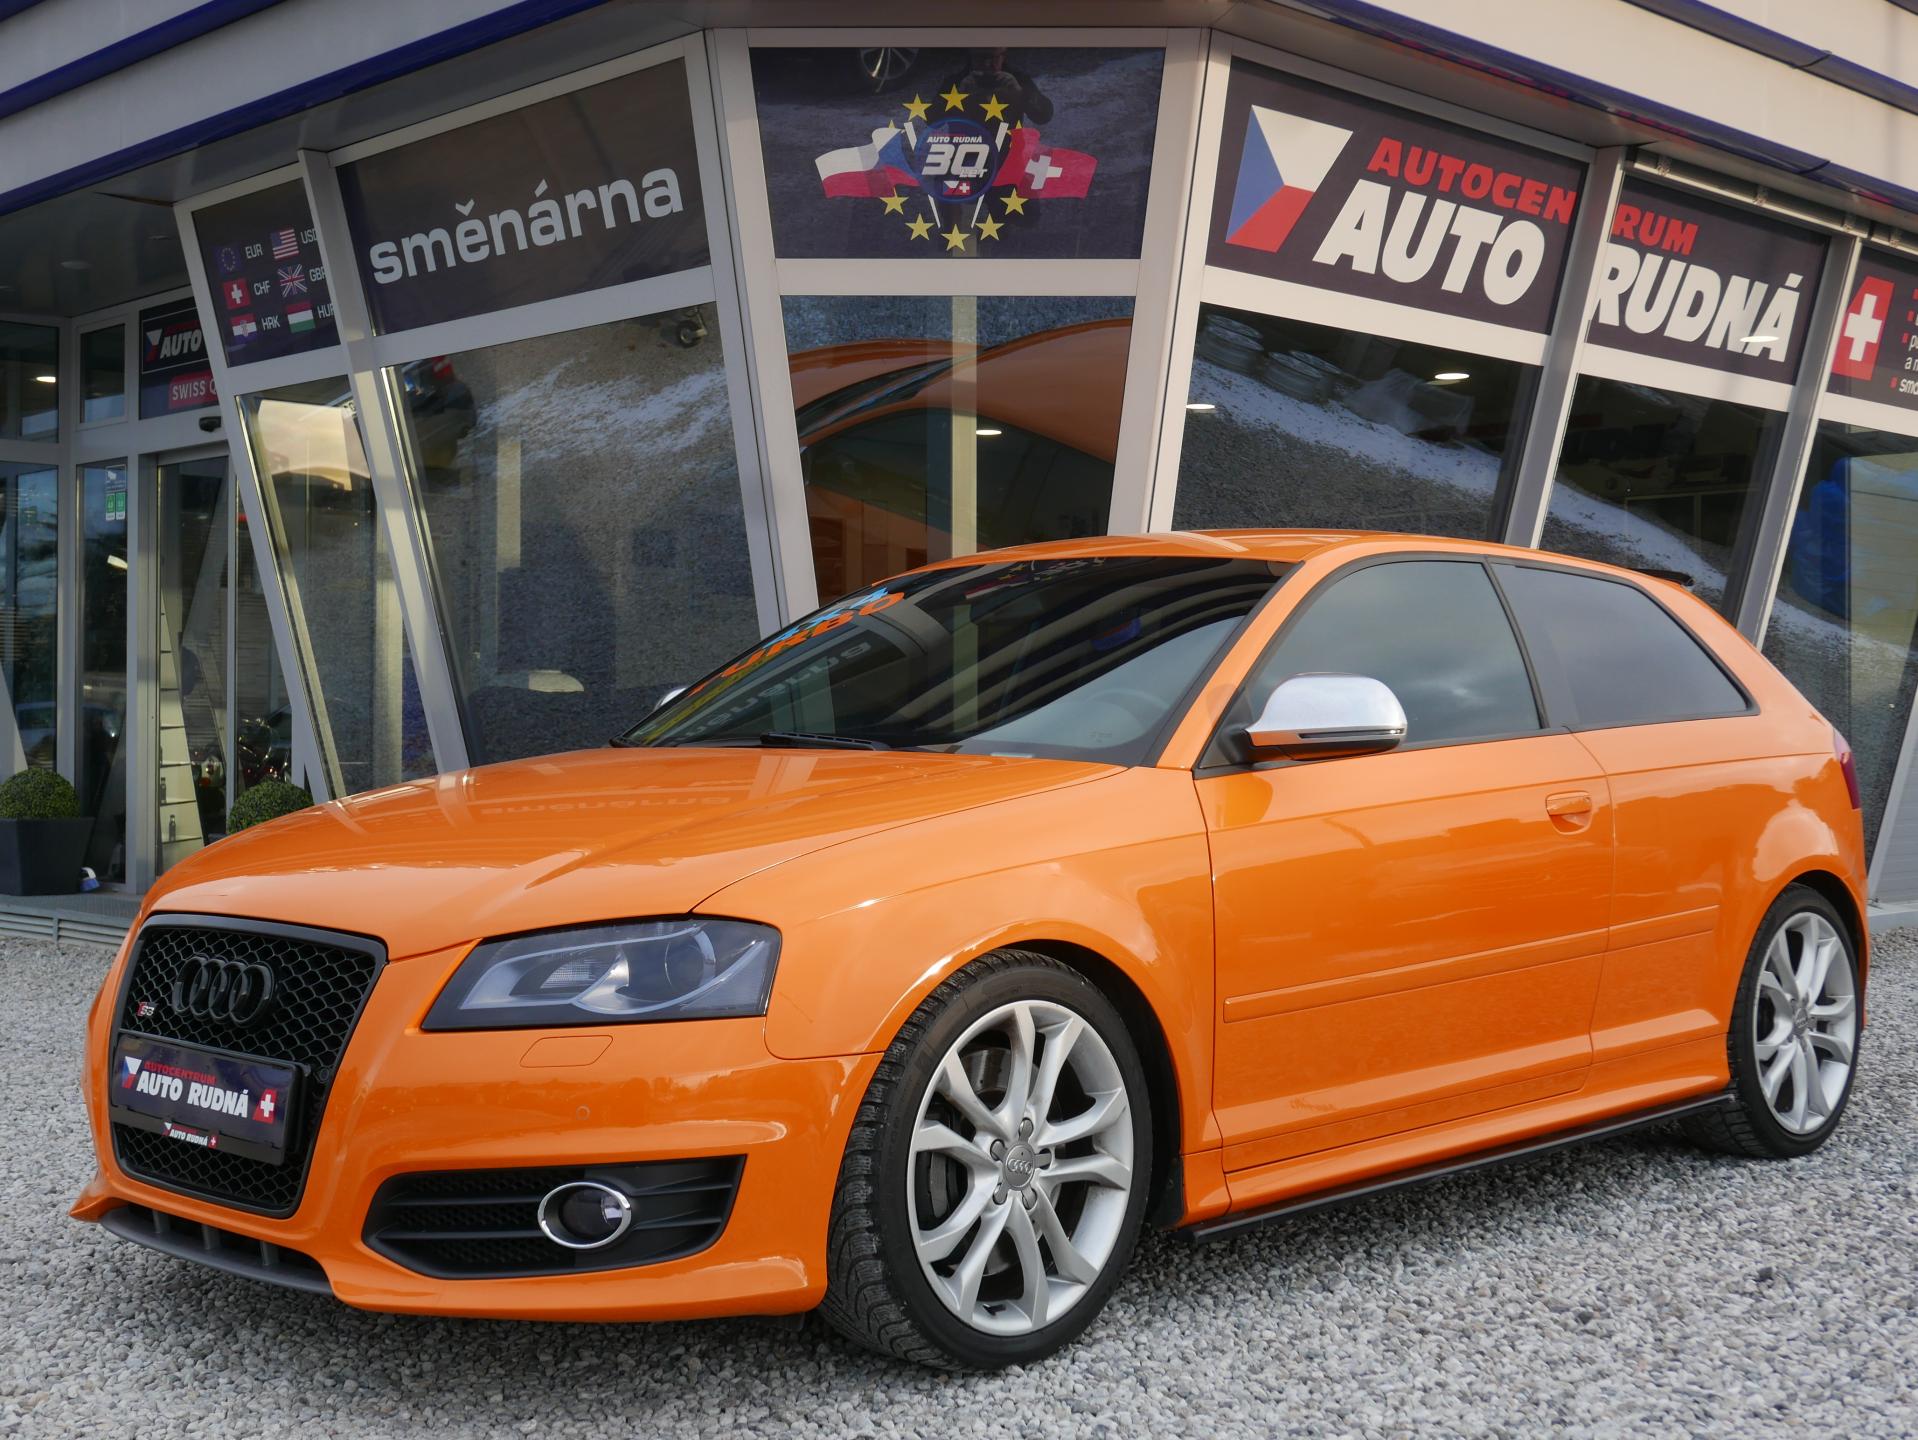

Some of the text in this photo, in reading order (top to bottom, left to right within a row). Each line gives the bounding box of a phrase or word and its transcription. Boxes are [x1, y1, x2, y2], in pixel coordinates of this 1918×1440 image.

[952, 135, 983, 143] RUDNÁ
[921, 143, 990, 176] 30
[369, 168, 684, 284] směnárna
[245, 243, 263, 259] EUR
[1312, 179, 1804, 363] AUTO RUDNÁ
[253, 280, 272, 296] CHF
[261, 315, 281, 330] HRK
[160, 328, 202, 359] AUTO
[172, 380, 206, 401] SWISS
[687, 592, 905, 698] TURBO
[144, 1061, 216, 1086] AUTOCENTRUM
[136, 1070, 249, 1118] AUTO RUDNÁ
[169, 1128, 186, 1140] AUTO
[186, 1133, 209, 1147] RUDNÁ
